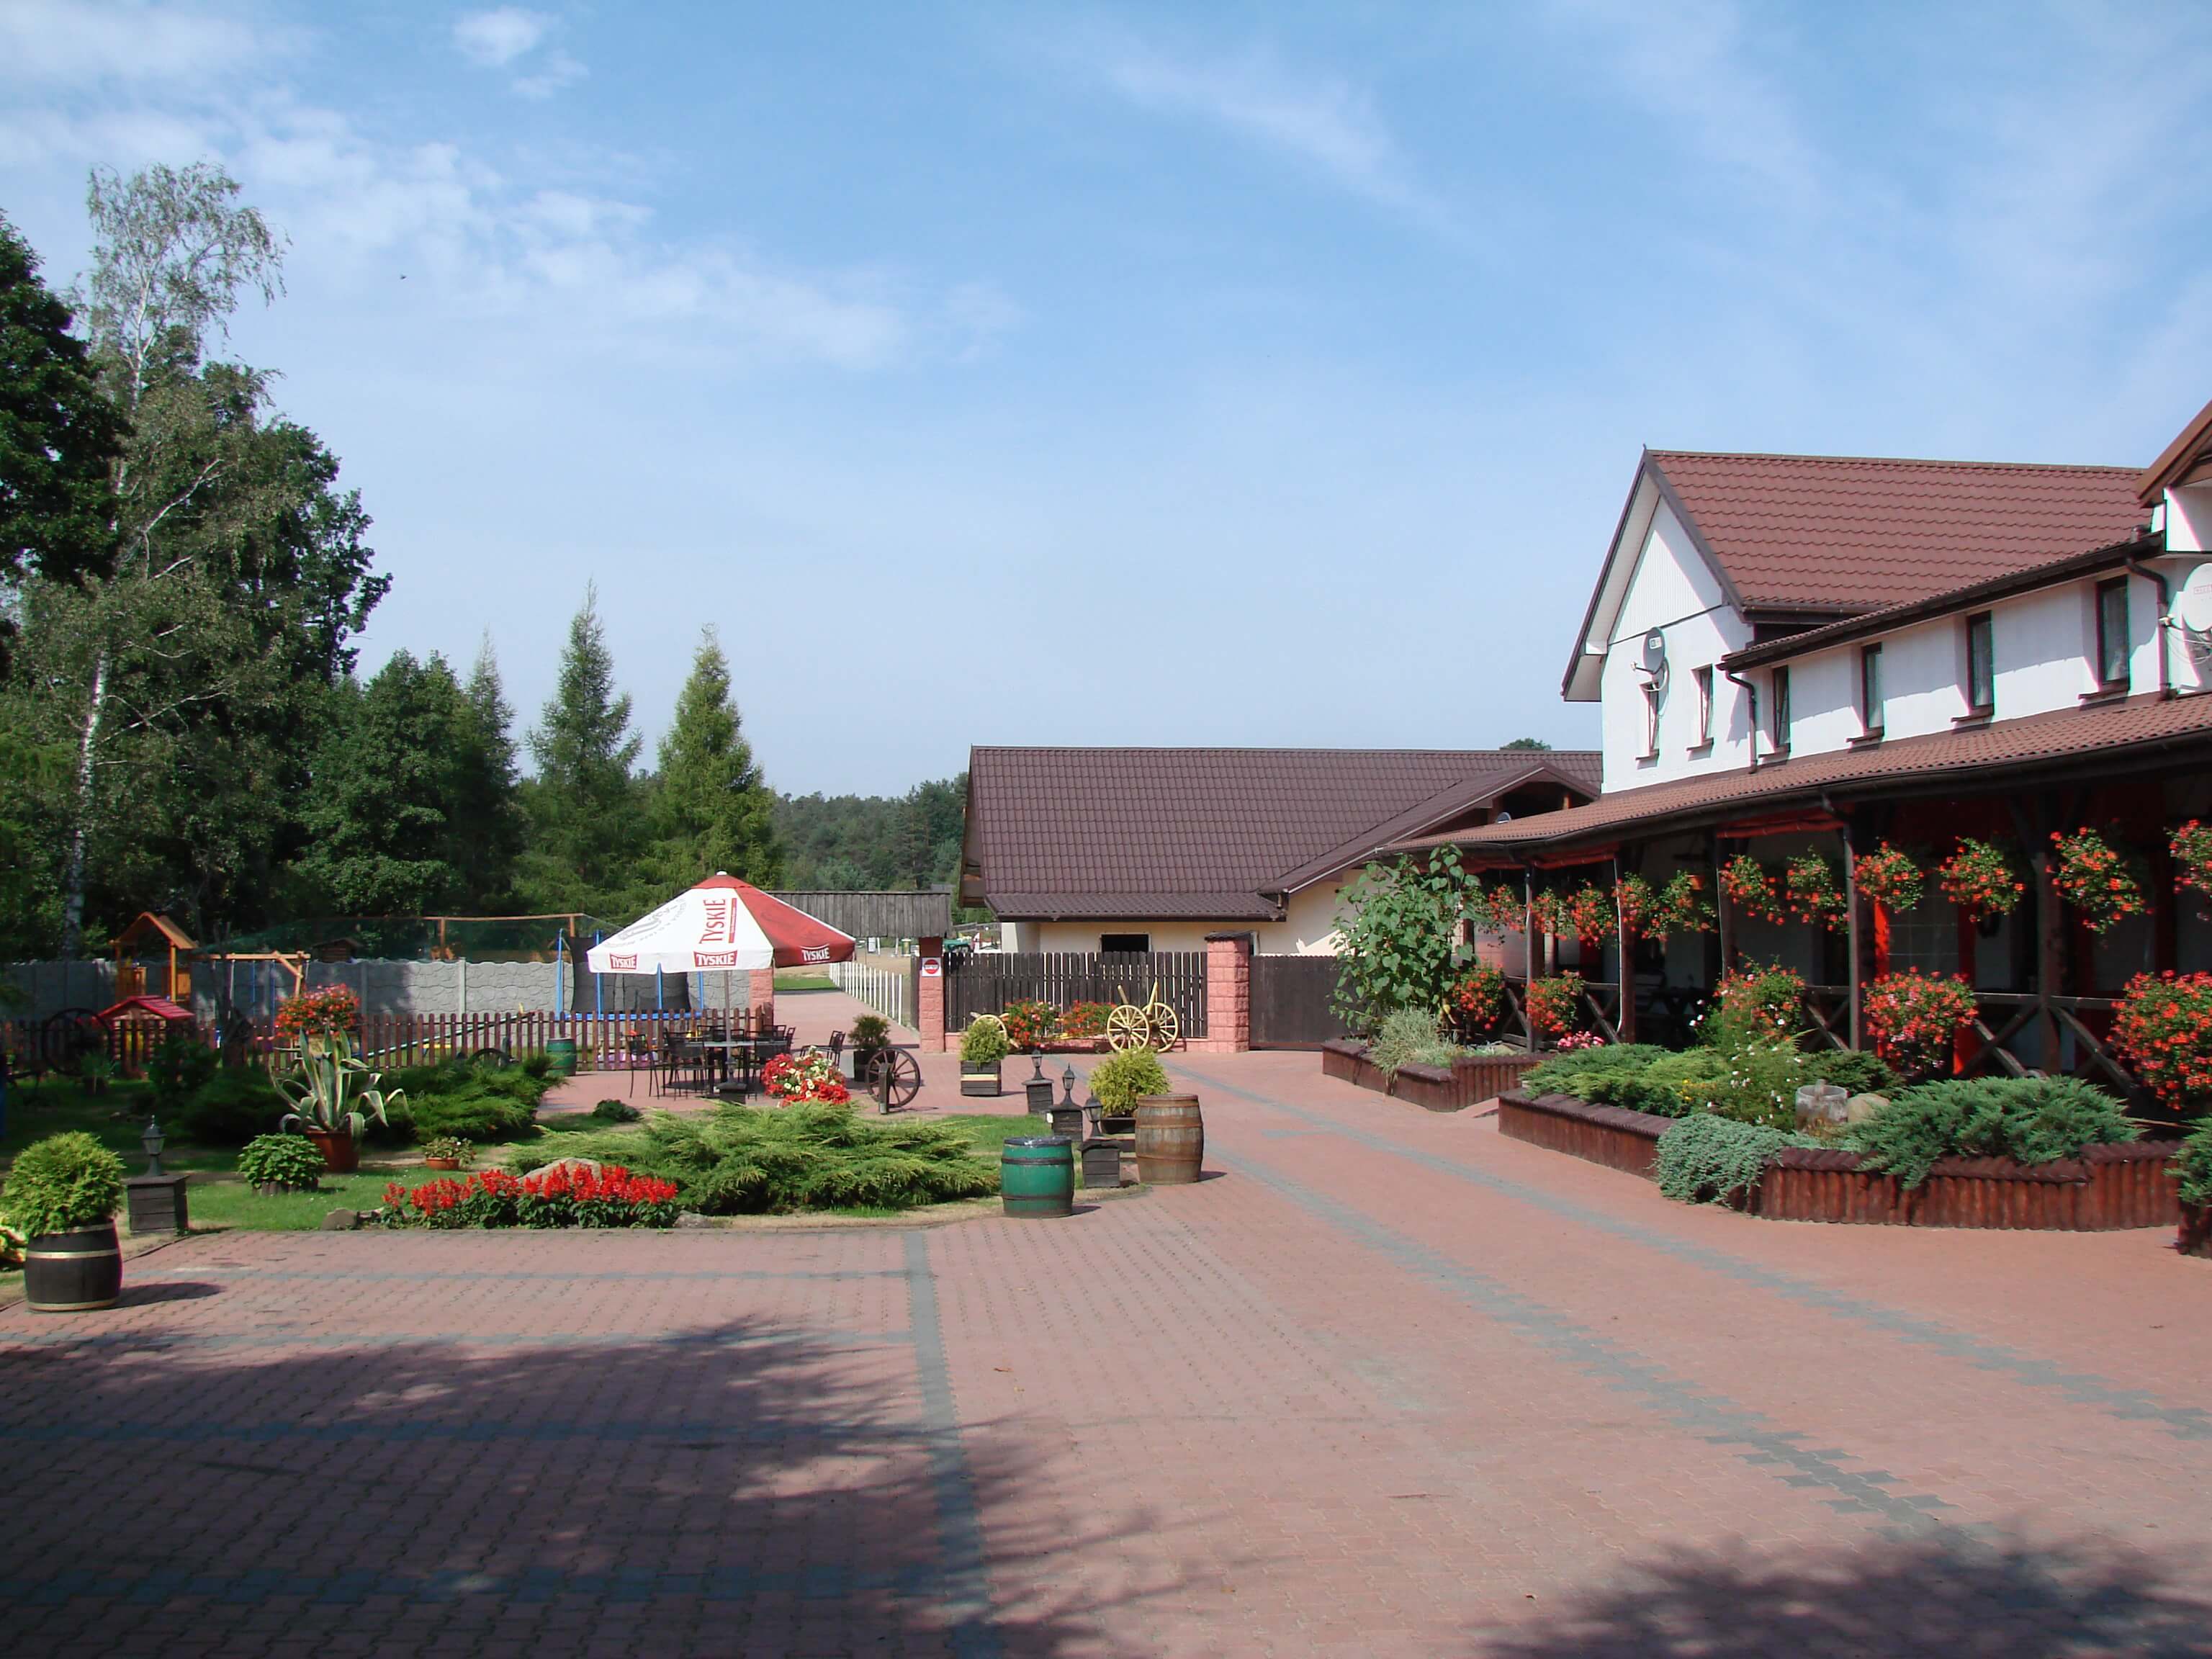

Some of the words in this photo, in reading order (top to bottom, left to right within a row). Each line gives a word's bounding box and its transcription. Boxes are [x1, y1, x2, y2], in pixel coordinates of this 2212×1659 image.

[698, 899, 726, 944] TYSKIE
[696, 953, 734, 966] TYSKIE
[801, 947, 830, 961] TYSKIE
[611, 956, 636, 968] TYSKIE
